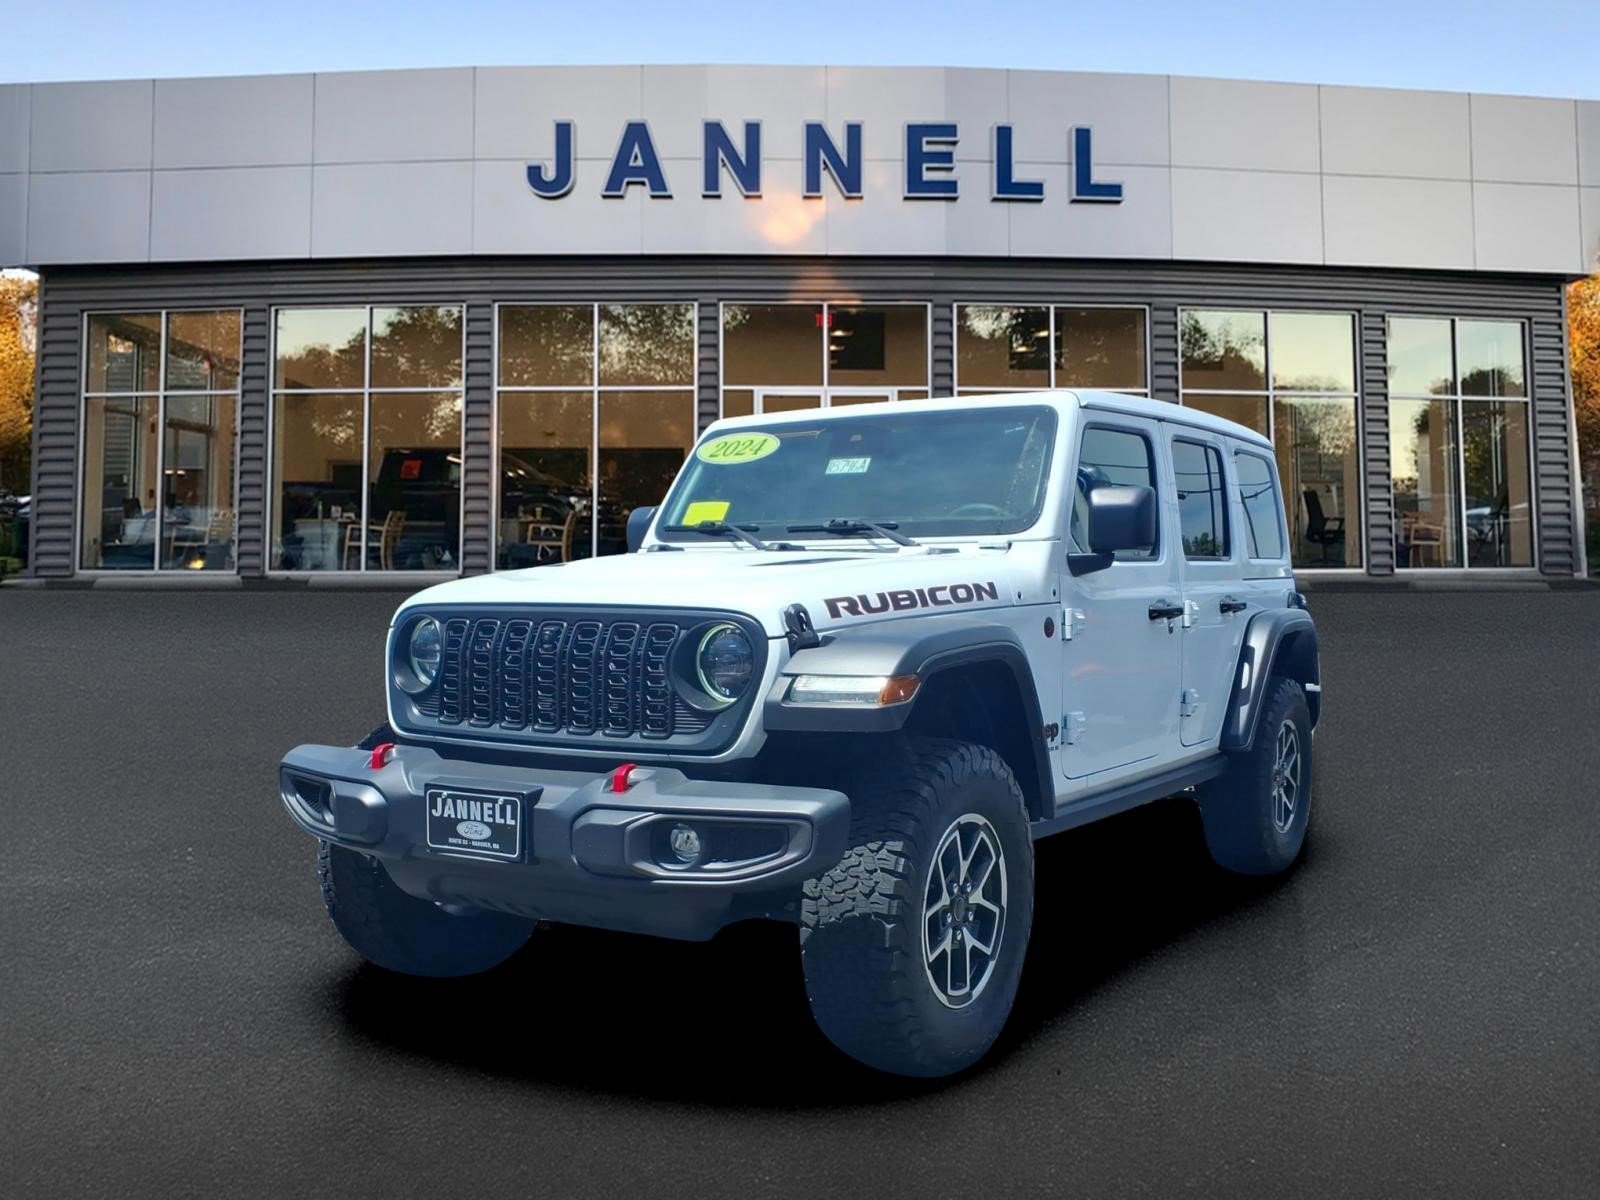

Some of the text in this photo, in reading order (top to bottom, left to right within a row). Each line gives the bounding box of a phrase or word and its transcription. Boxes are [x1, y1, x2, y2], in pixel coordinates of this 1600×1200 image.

[526, 119, 1124, 203] JANNELL
[708, 437, 768, 459] 2024
[823, 581, 999, 619] RUBICON
[431, 797, 516, 825] JANNELL
